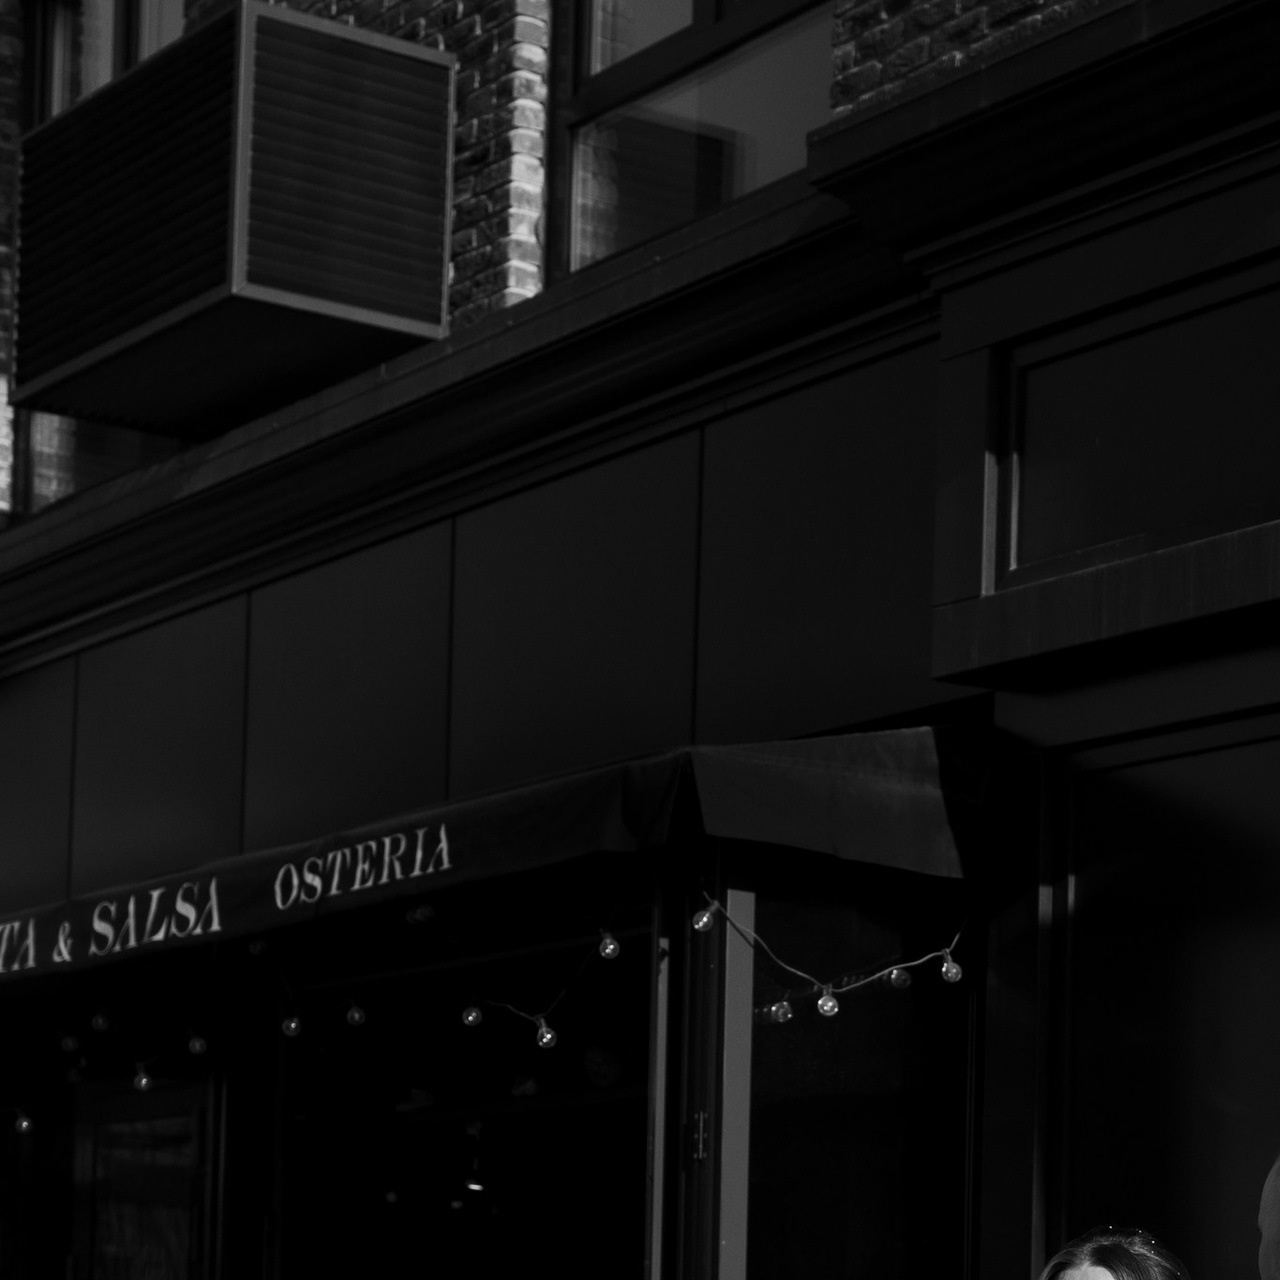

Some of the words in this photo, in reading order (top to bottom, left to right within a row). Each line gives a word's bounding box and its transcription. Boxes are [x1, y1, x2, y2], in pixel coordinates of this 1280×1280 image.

[52, 920, 73, 963] &
[88, 876, 222, 958] SALSA
[273, 822, 453, 911] OSTERIA
